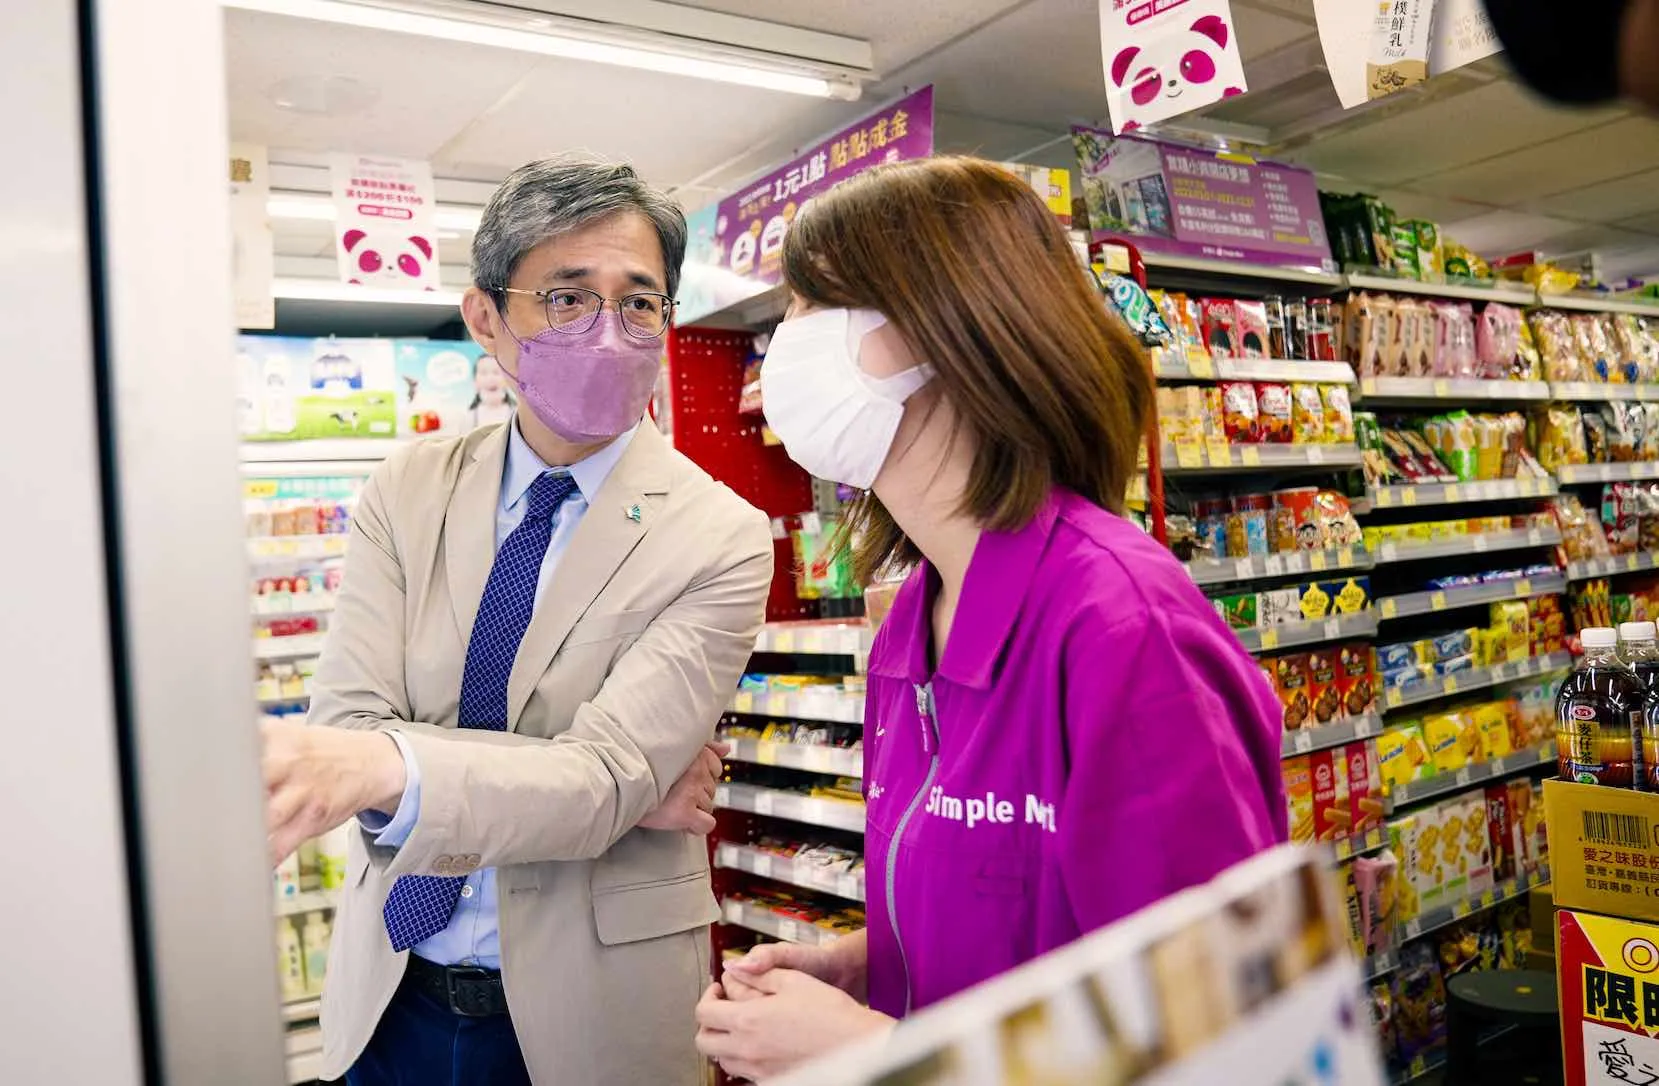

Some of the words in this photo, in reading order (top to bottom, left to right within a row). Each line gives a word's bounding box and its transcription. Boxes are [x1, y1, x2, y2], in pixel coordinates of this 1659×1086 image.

[829, 110, 908, 172] 點點成金
[925, 784, 1016, 829] Simple
